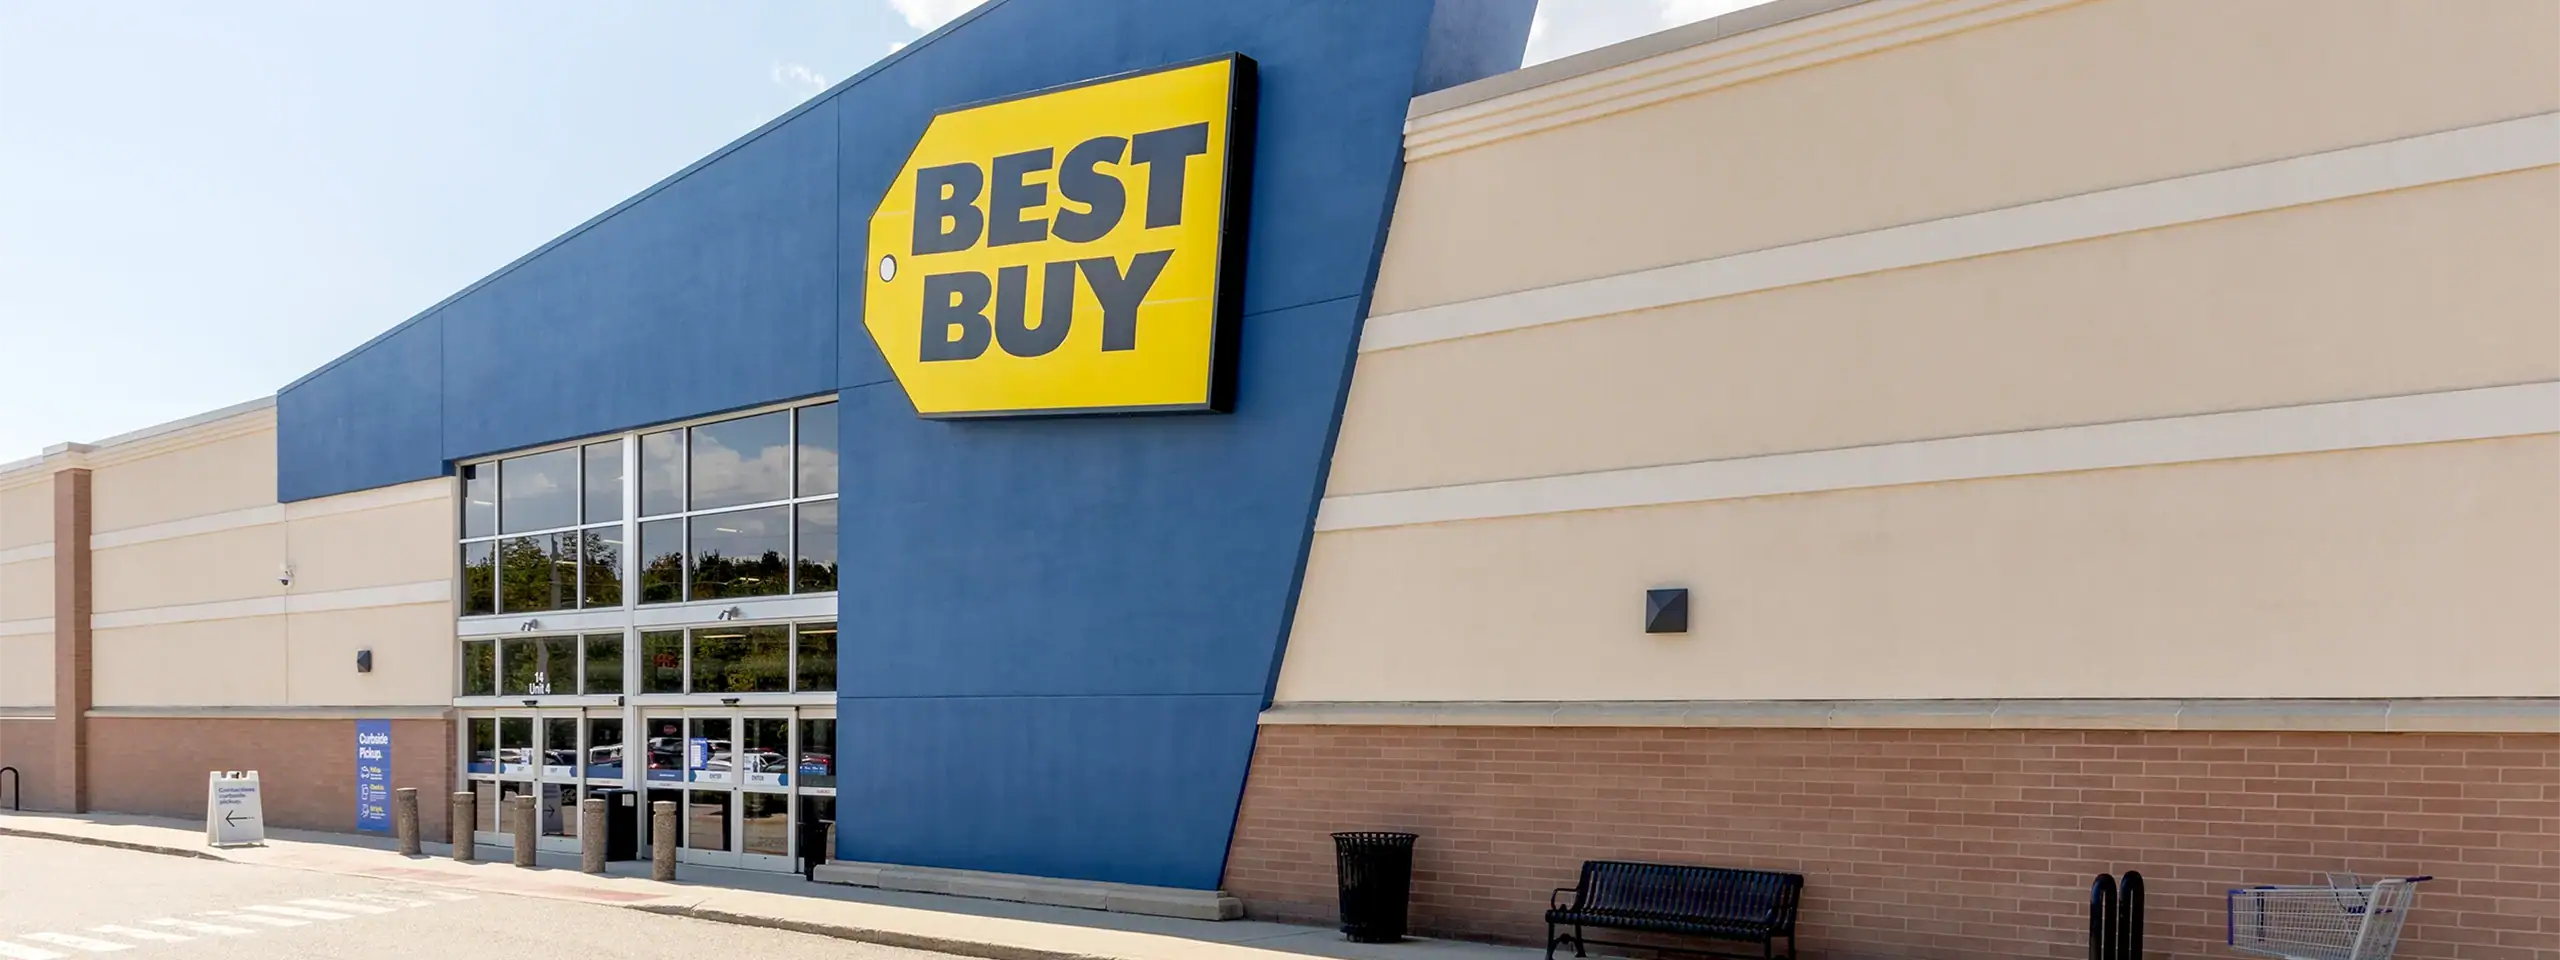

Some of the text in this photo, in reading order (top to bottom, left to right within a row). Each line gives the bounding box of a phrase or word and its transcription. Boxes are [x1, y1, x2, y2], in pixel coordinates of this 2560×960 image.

[911, 121, 1209, 256] BEST
[919, 249, 1176, 363] BUY
[534, 671, 544, 683] 14
[529, 682, 551, 695] Unit 4
[359, 732, 389, 745] Curbside
[359, 747, 383, 761] Pickup.
